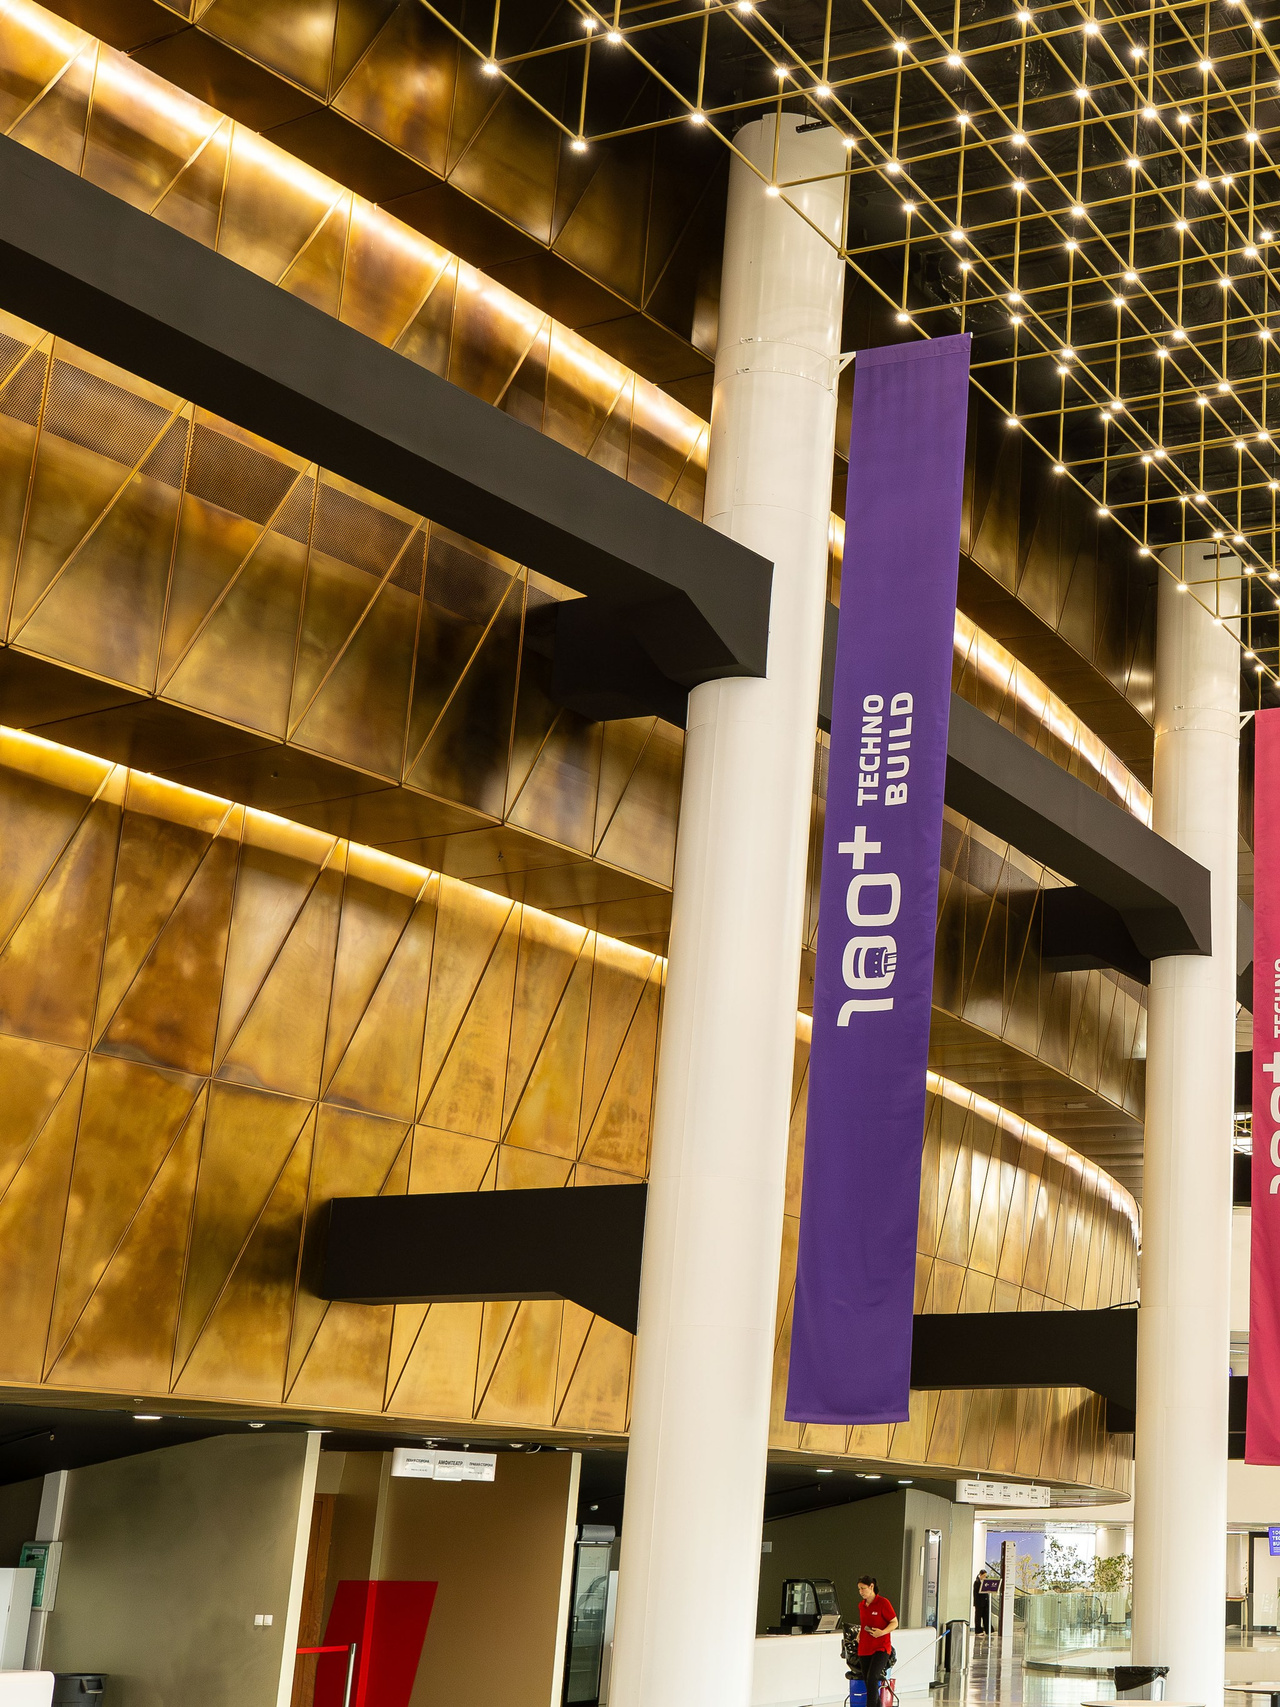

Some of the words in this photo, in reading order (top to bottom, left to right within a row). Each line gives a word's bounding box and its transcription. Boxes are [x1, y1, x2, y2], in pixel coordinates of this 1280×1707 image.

[856, 692, 885, 807] TECHNO
[885, 691, 914, 807] BUILD
[837, 826, 902, 1028] 100+
